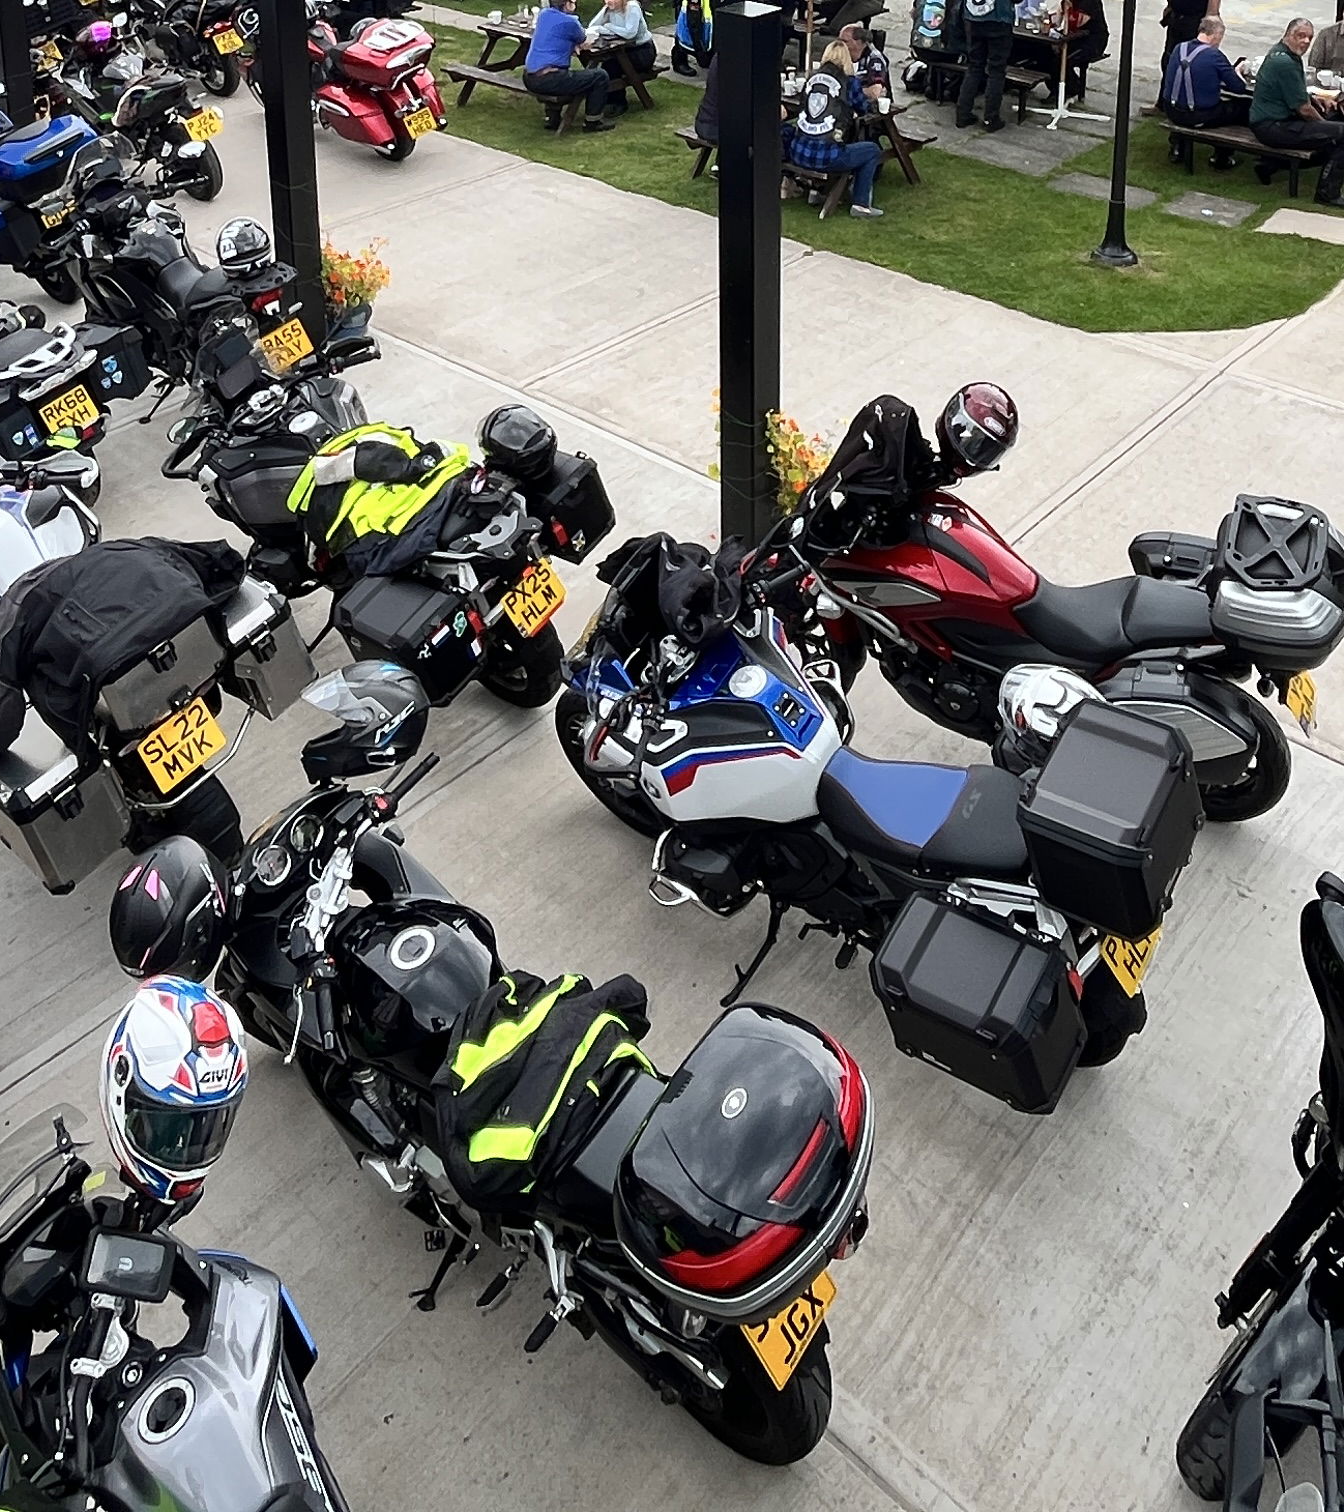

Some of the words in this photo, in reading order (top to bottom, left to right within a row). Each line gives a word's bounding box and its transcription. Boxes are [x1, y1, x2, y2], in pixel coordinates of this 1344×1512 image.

[187, 112, 215, 131] PJ24
[195, 123, 217, 139] YYC
[42, 388, 88, 424] RK68
[504, 563, 551, 615] PX25
[520, 584, 558, 627] HLM
[142, 704, 209, 764] SL22
[162, 730, 214, 781] MVK
[199, 1068, 229, 1083] GIVI
[780, 1284, 825, 1365] JGX
